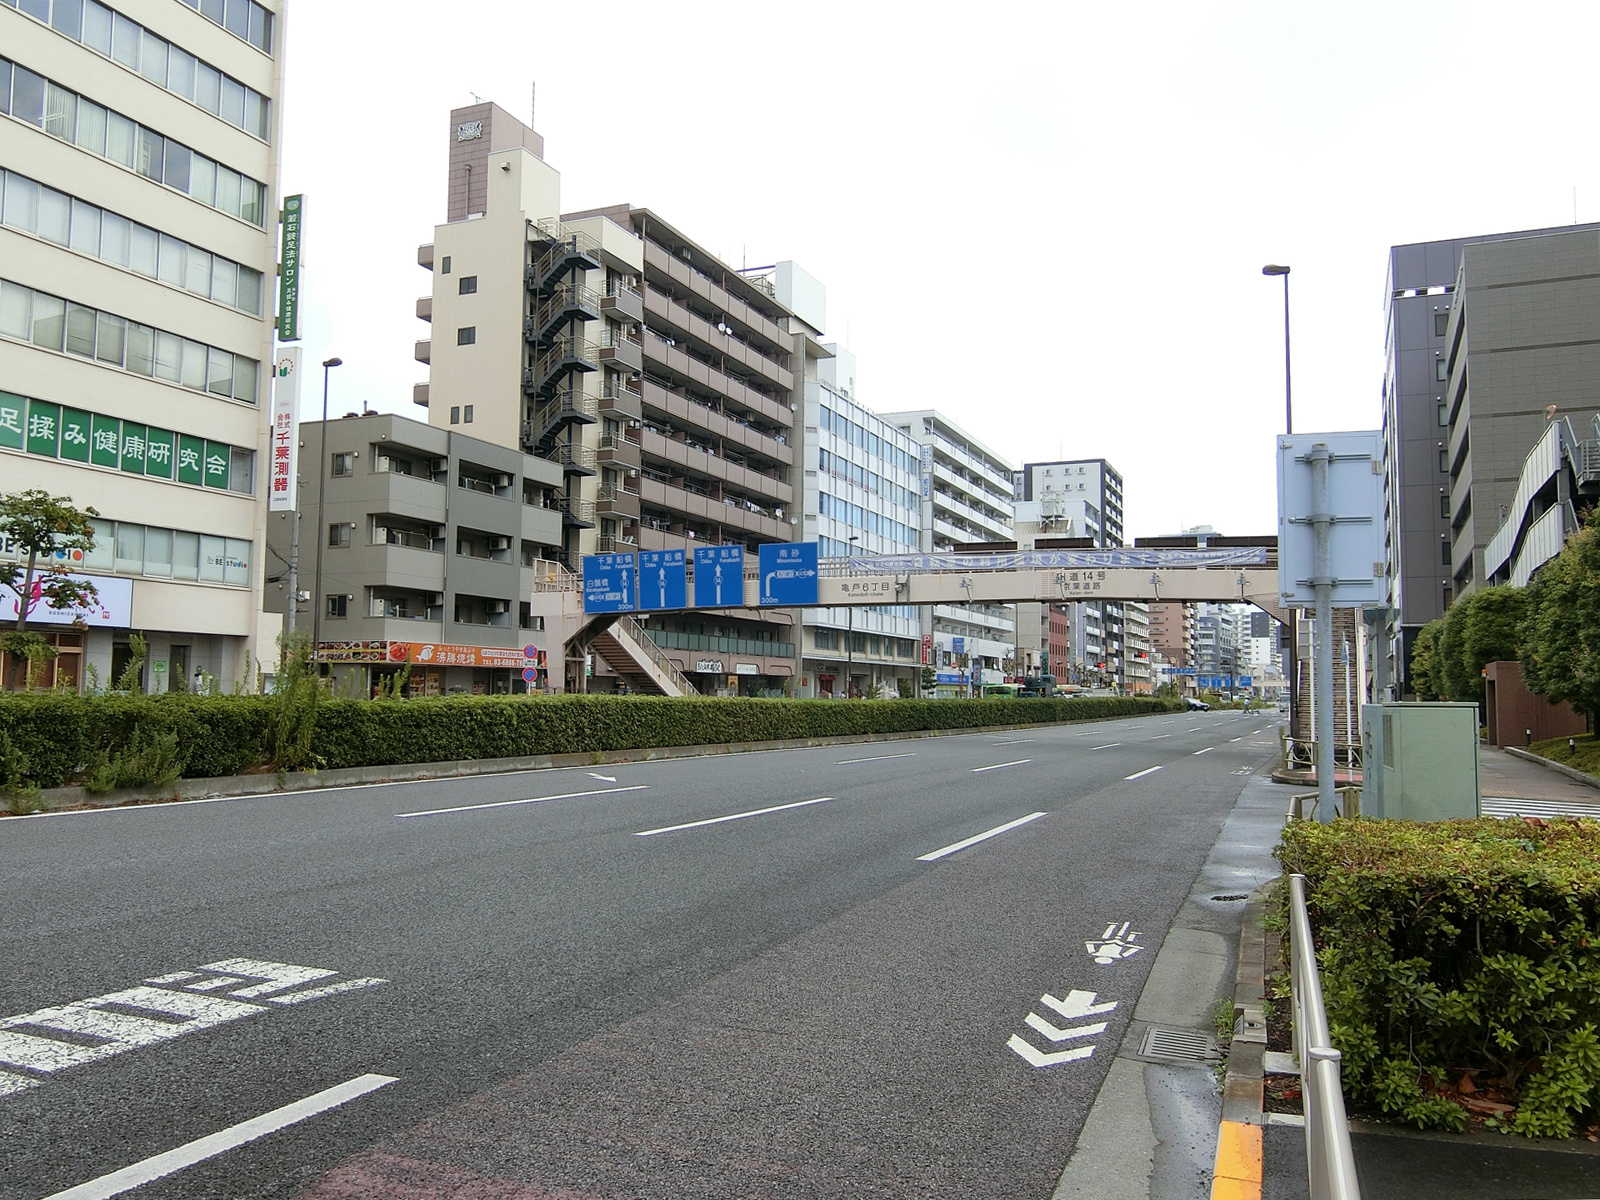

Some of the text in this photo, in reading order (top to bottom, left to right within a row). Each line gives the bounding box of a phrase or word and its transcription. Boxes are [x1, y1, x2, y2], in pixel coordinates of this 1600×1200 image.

[0, 407, 226, 475] 足揉み健康研究会
[274, 430, 290, 492] 千葉測器
[642, 552, 682, 563] 千葉 船橋
[697, 548, 739, 559] 千葉 船橋
[779, 549, 800, 558] 南砂
[598, 555, 632, 565] 千葉 船橋
[841, 582, 890, 593] 亀戸6丁目
